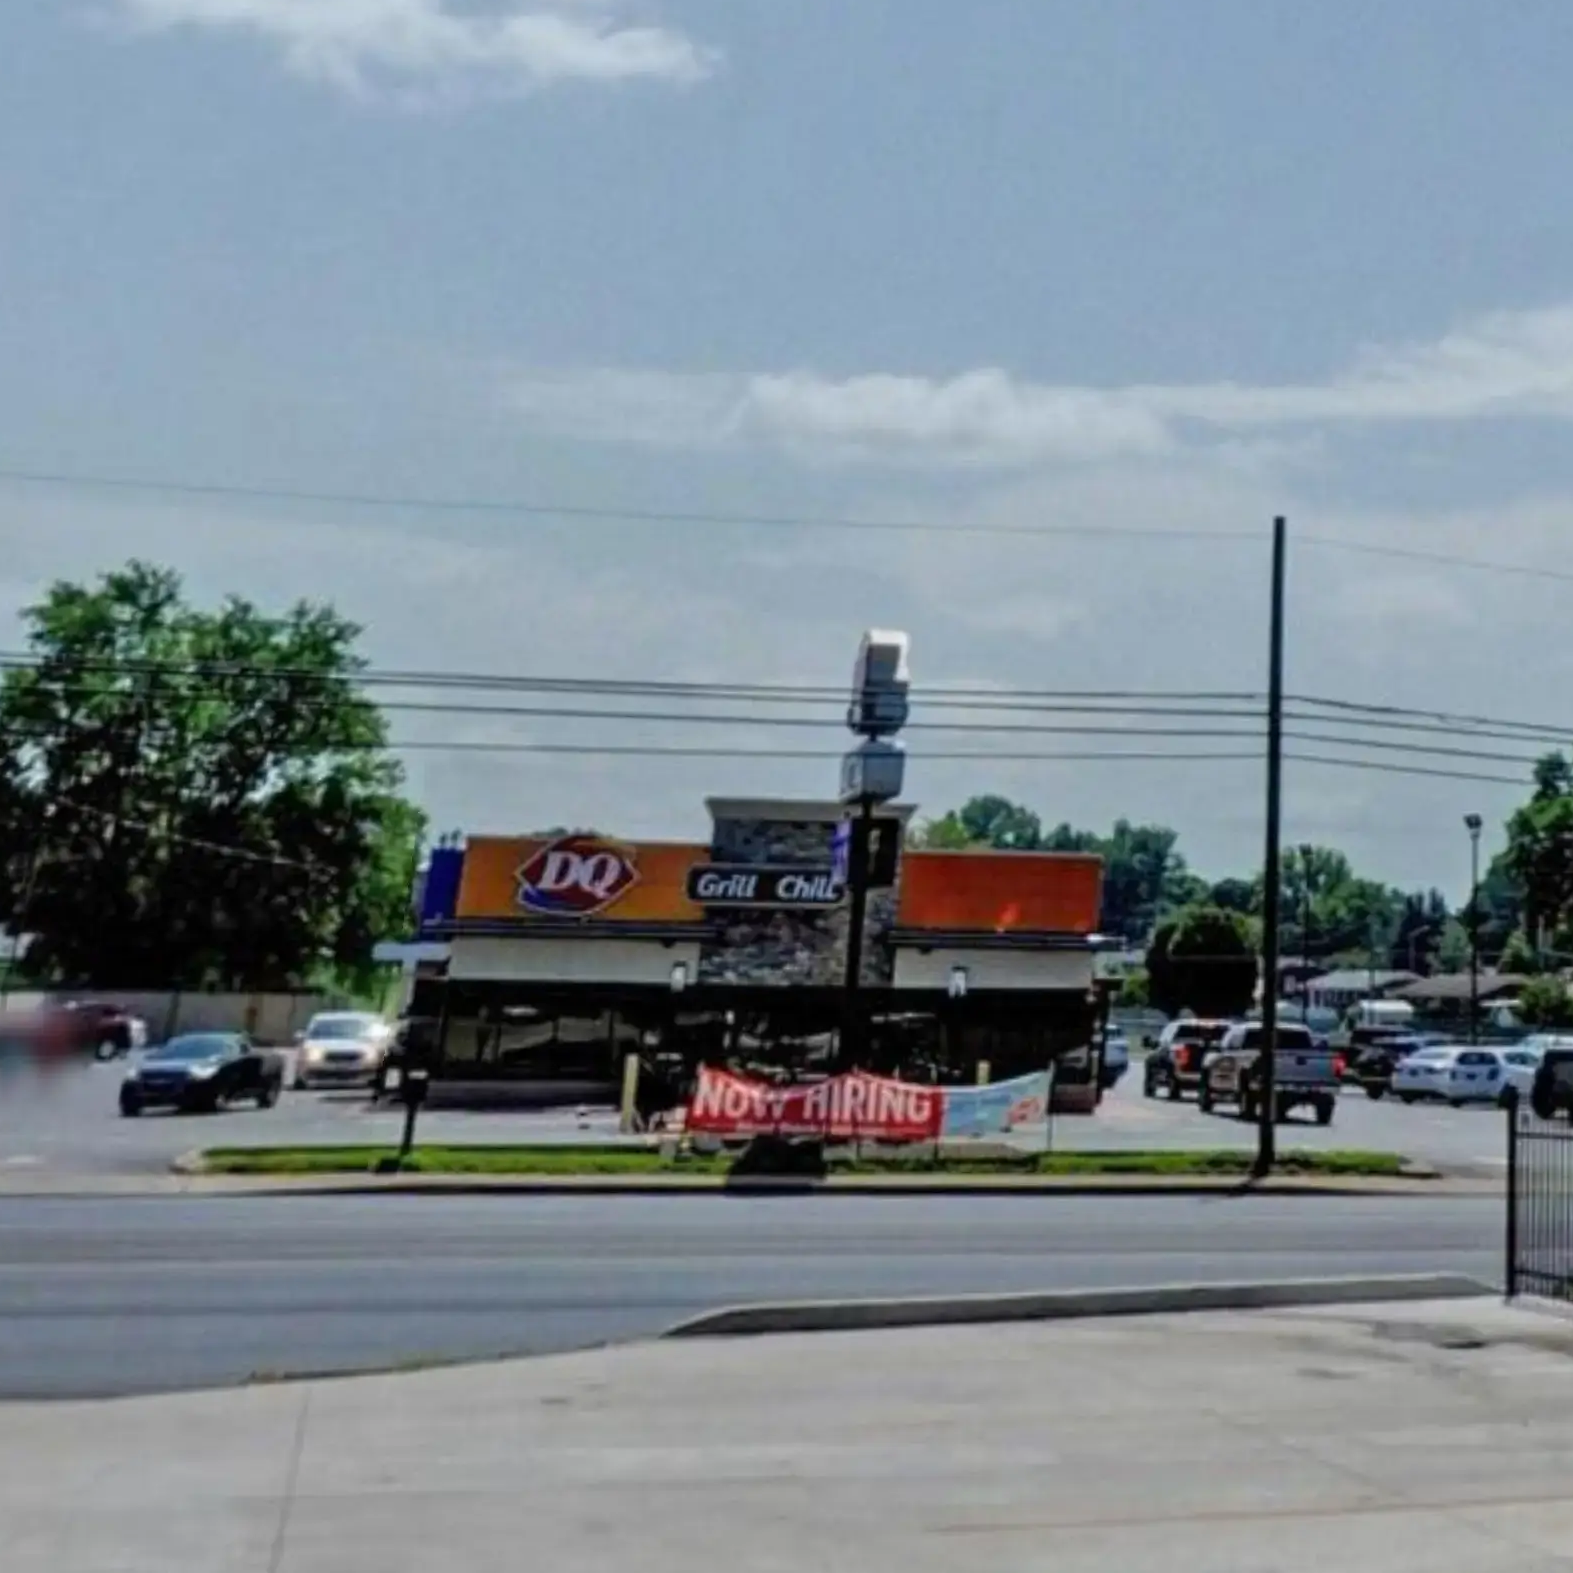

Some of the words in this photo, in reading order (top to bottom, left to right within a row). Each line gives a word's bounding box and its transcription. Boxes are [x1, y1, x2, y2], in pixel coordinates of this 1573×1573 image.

[539, 849, 622, 898] DQ
[696, 873, 758, 898] Grill
[776, 873, 838, 900] Chill
[692, 1074, 789, 1122] NOW
[802, 1076, 933, 1124] HIRING
